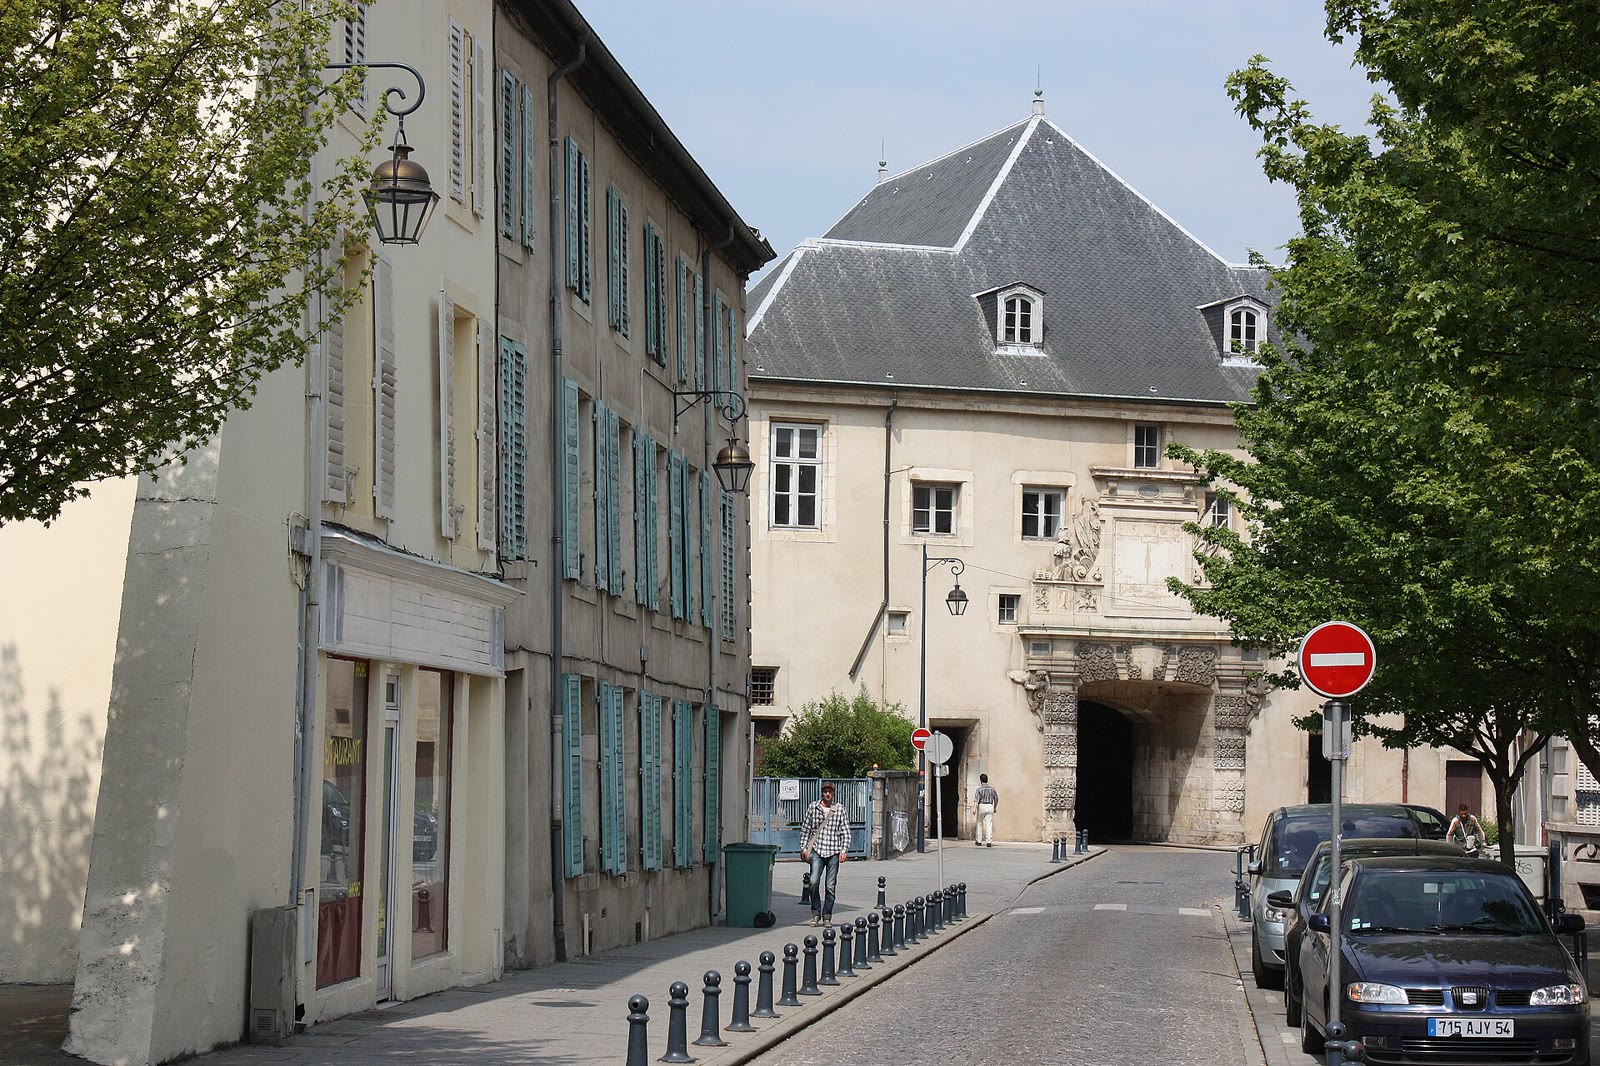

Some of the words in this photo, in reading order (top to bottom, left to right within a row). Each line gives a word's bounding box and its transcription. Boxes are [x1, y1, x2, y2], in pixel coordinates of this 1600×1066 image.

[1439, 1021, 1461, 1034] 715
[1467, 1021, 1490, 1034] AJY
[1496, 1022, 1510, 1035] 54
